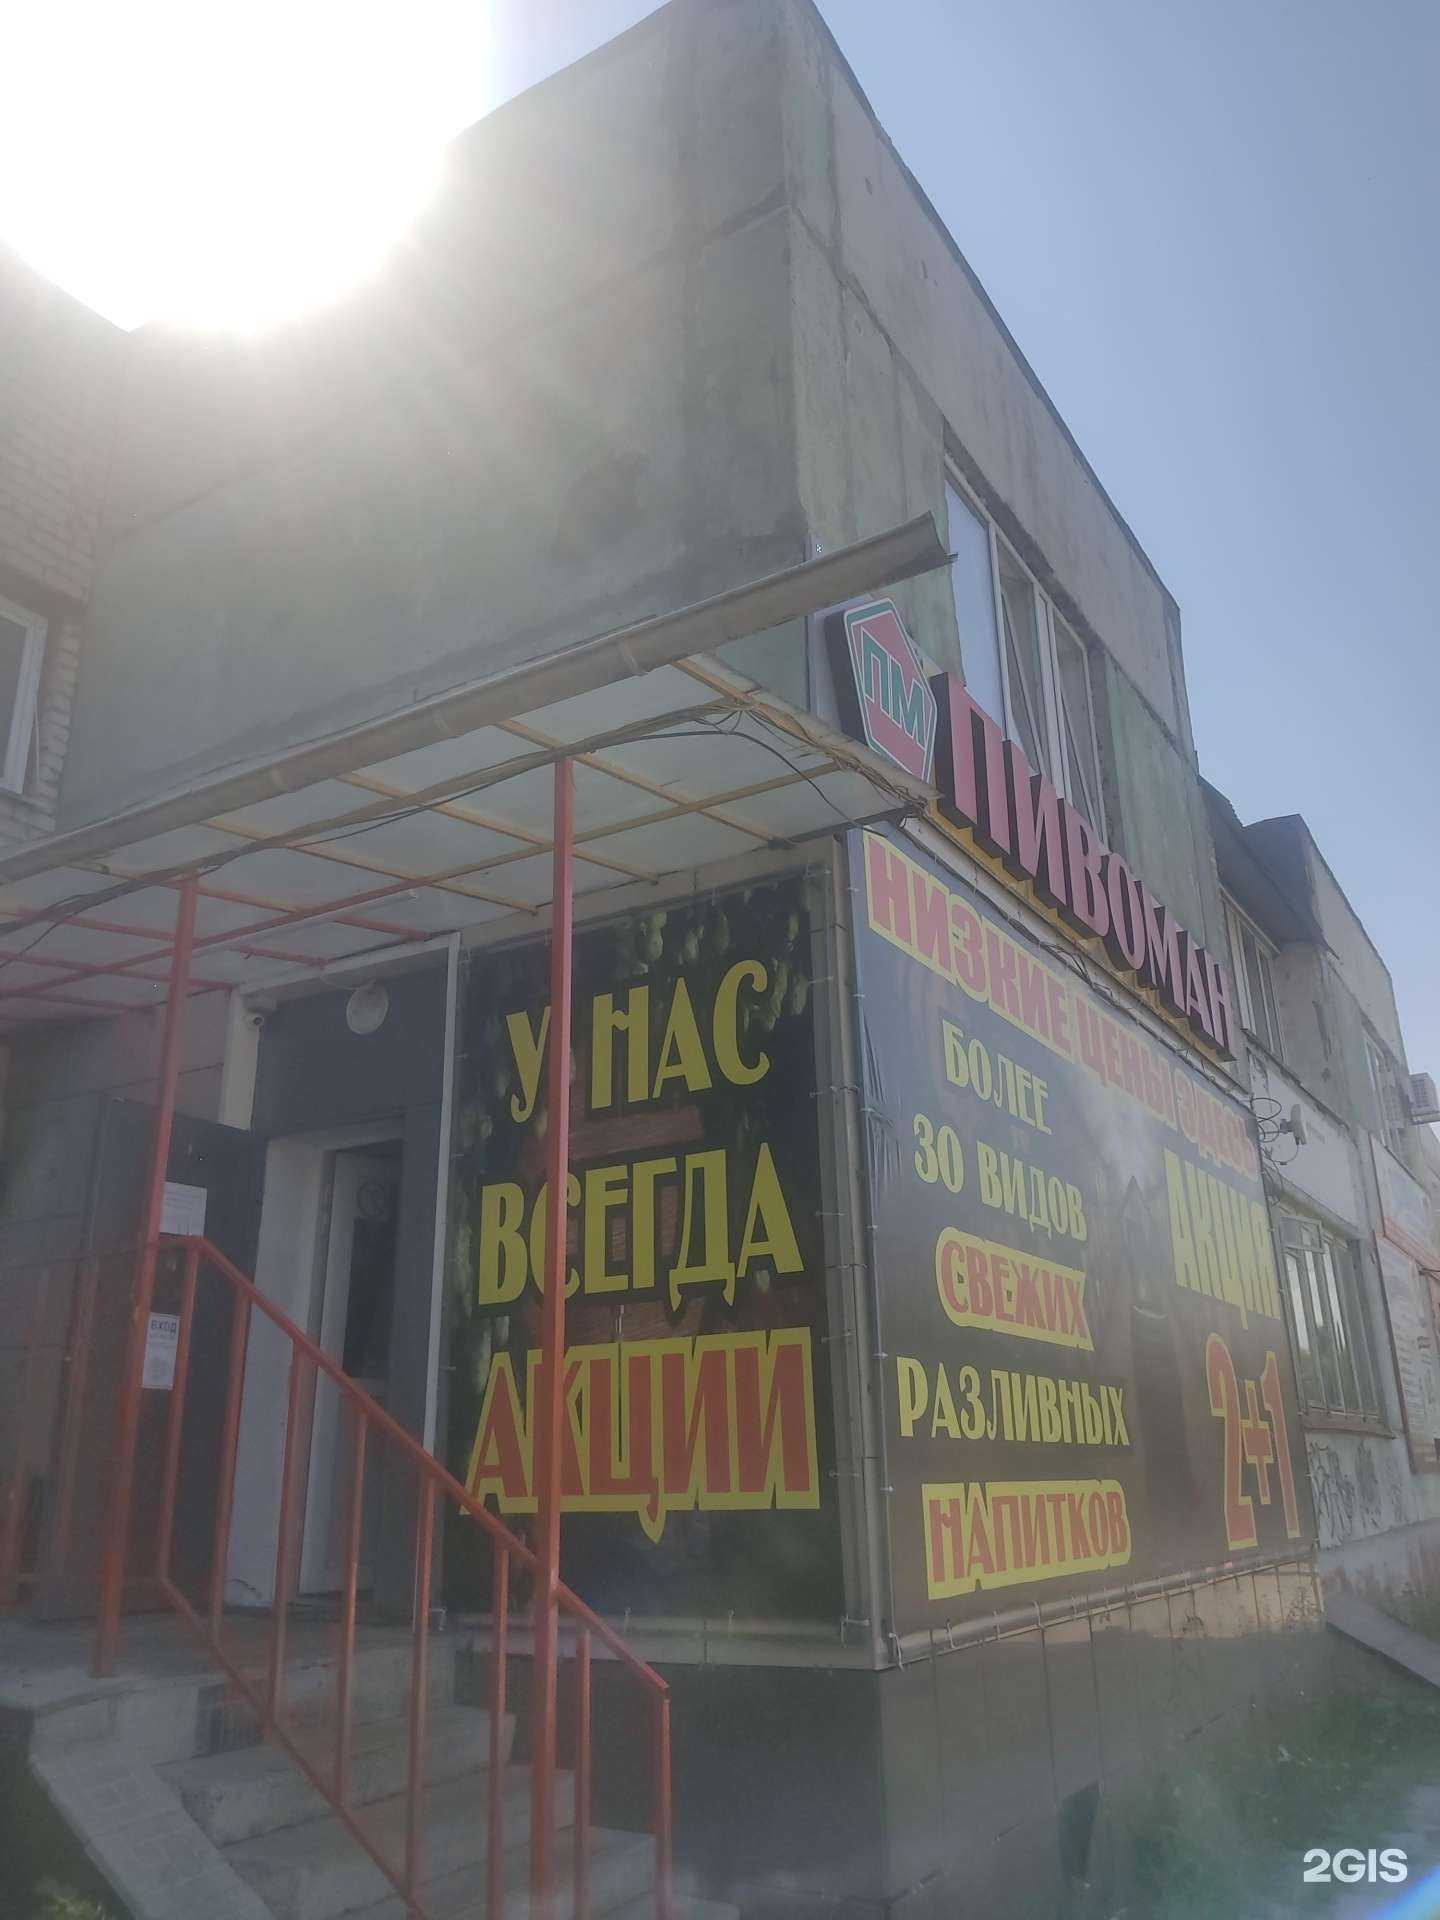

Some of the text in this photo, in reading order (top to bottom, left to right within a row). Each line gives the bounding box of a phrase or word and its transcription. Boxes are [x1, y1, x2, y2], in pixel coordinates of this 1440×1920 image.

[861, 625, 927, 749] ПМ
[945, 672, 1236, 1055] ПИВОМАН
[506, 960, 770, 1124] У НАС
[866, 831, 1074, 1058] НИЗКИЕ
[1075, 993, 1175, 1128] ЦЕНЫ
[941, 1018, 1052, 1135] БОЛЕЕ
[478, 1142, 804, 1312] ВСЕГДА
[912, 1112, 1087, 1241] 30 ВИДОВ
[1164, 1147, 1281, 1330] АКЦИЯ
[938, 1233, 1090, 1343] СВЕЖИХ
[459, 1327, 820, 1544] АКЦИИ
[897, 1356, 1130, 1446] РАЗЛИВНЫХ
[1205, 1332, 1301, 1552] 2+1
[925, 1484, 1129, 1590] НАПИТКОВ
